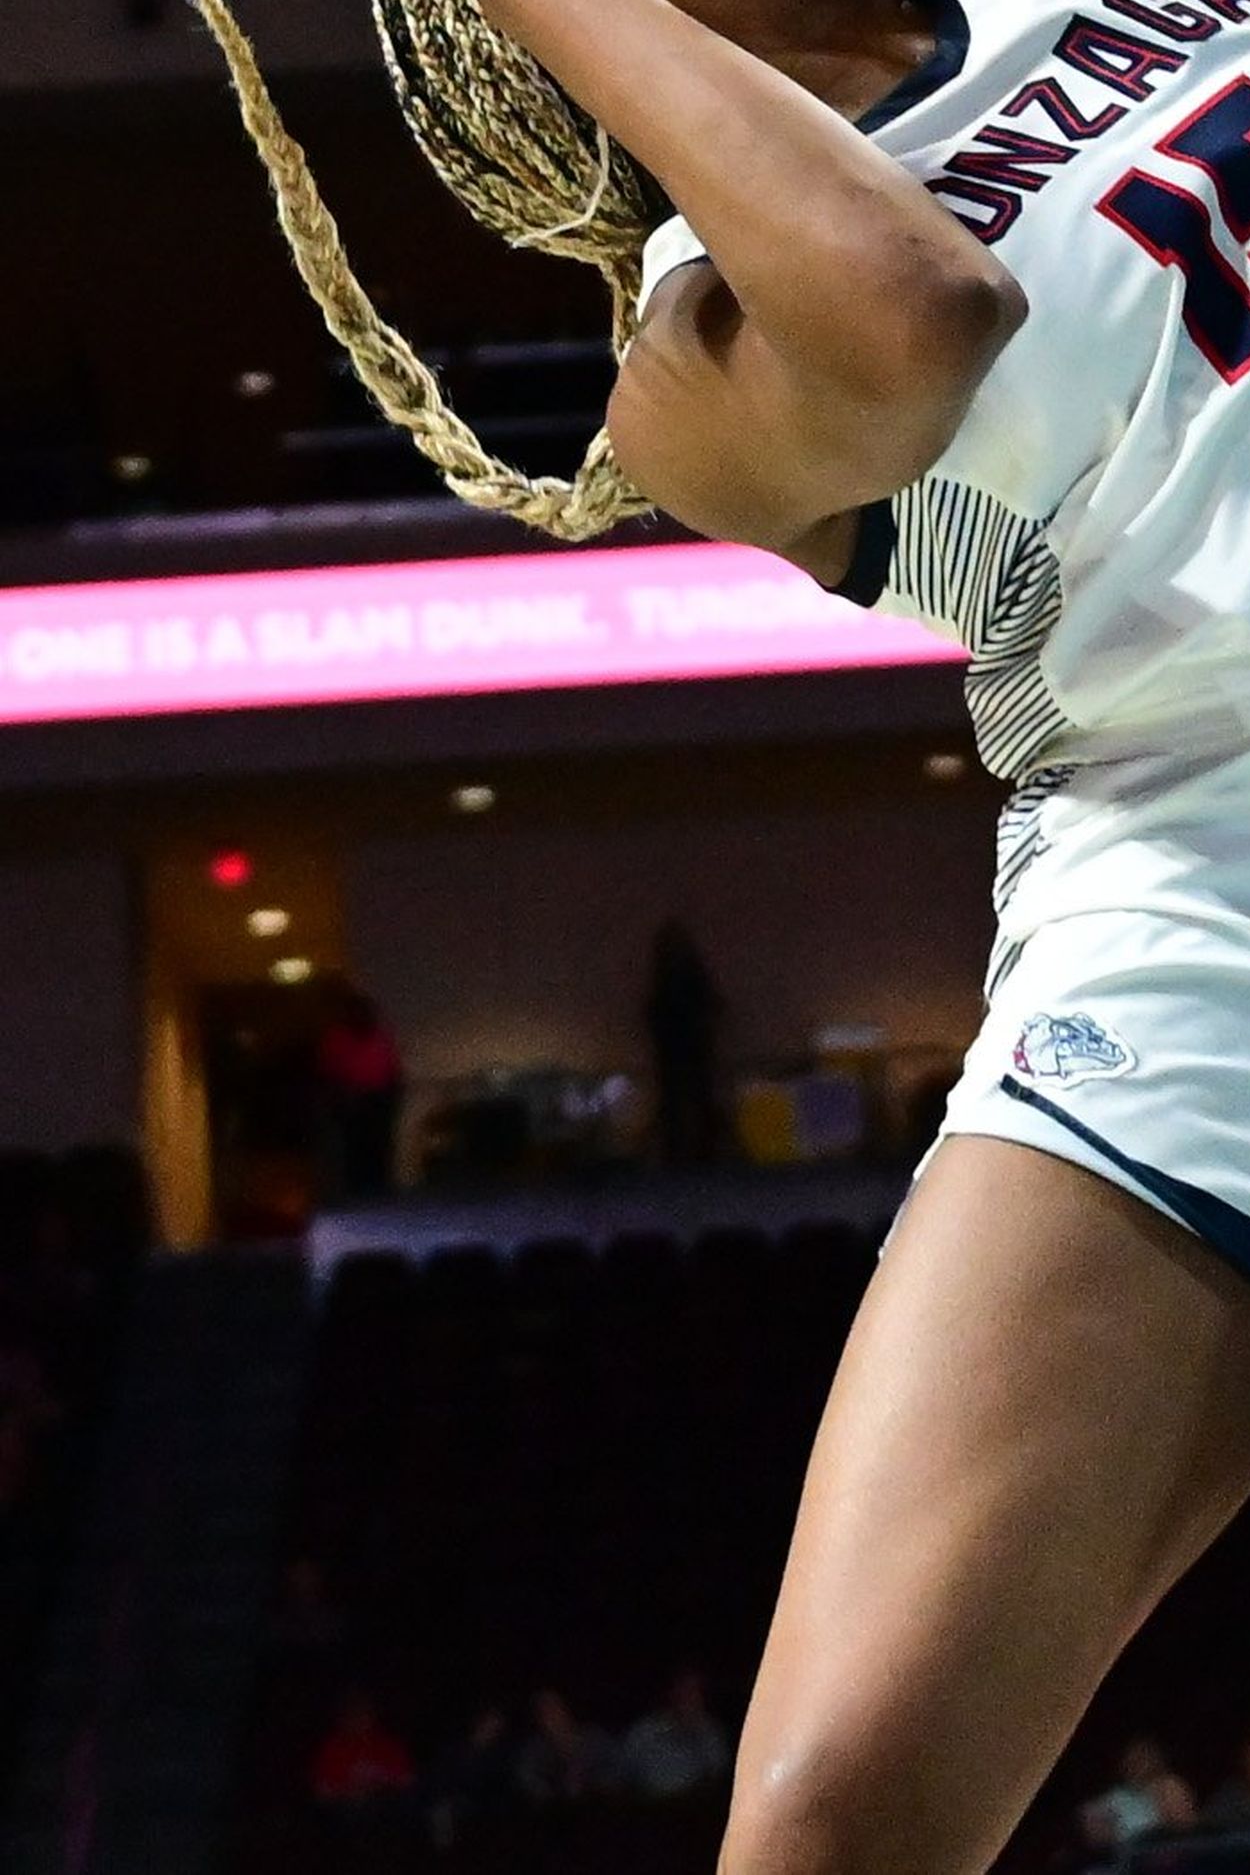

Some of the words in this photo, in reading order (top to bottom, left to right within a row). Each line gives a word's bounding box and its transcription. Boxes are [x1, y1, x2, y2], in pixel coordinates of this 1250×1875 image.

[145, 617, 196, 673] IS
[207, 614, 249, 668] A
[255, 605, 411, 665] SLAM
